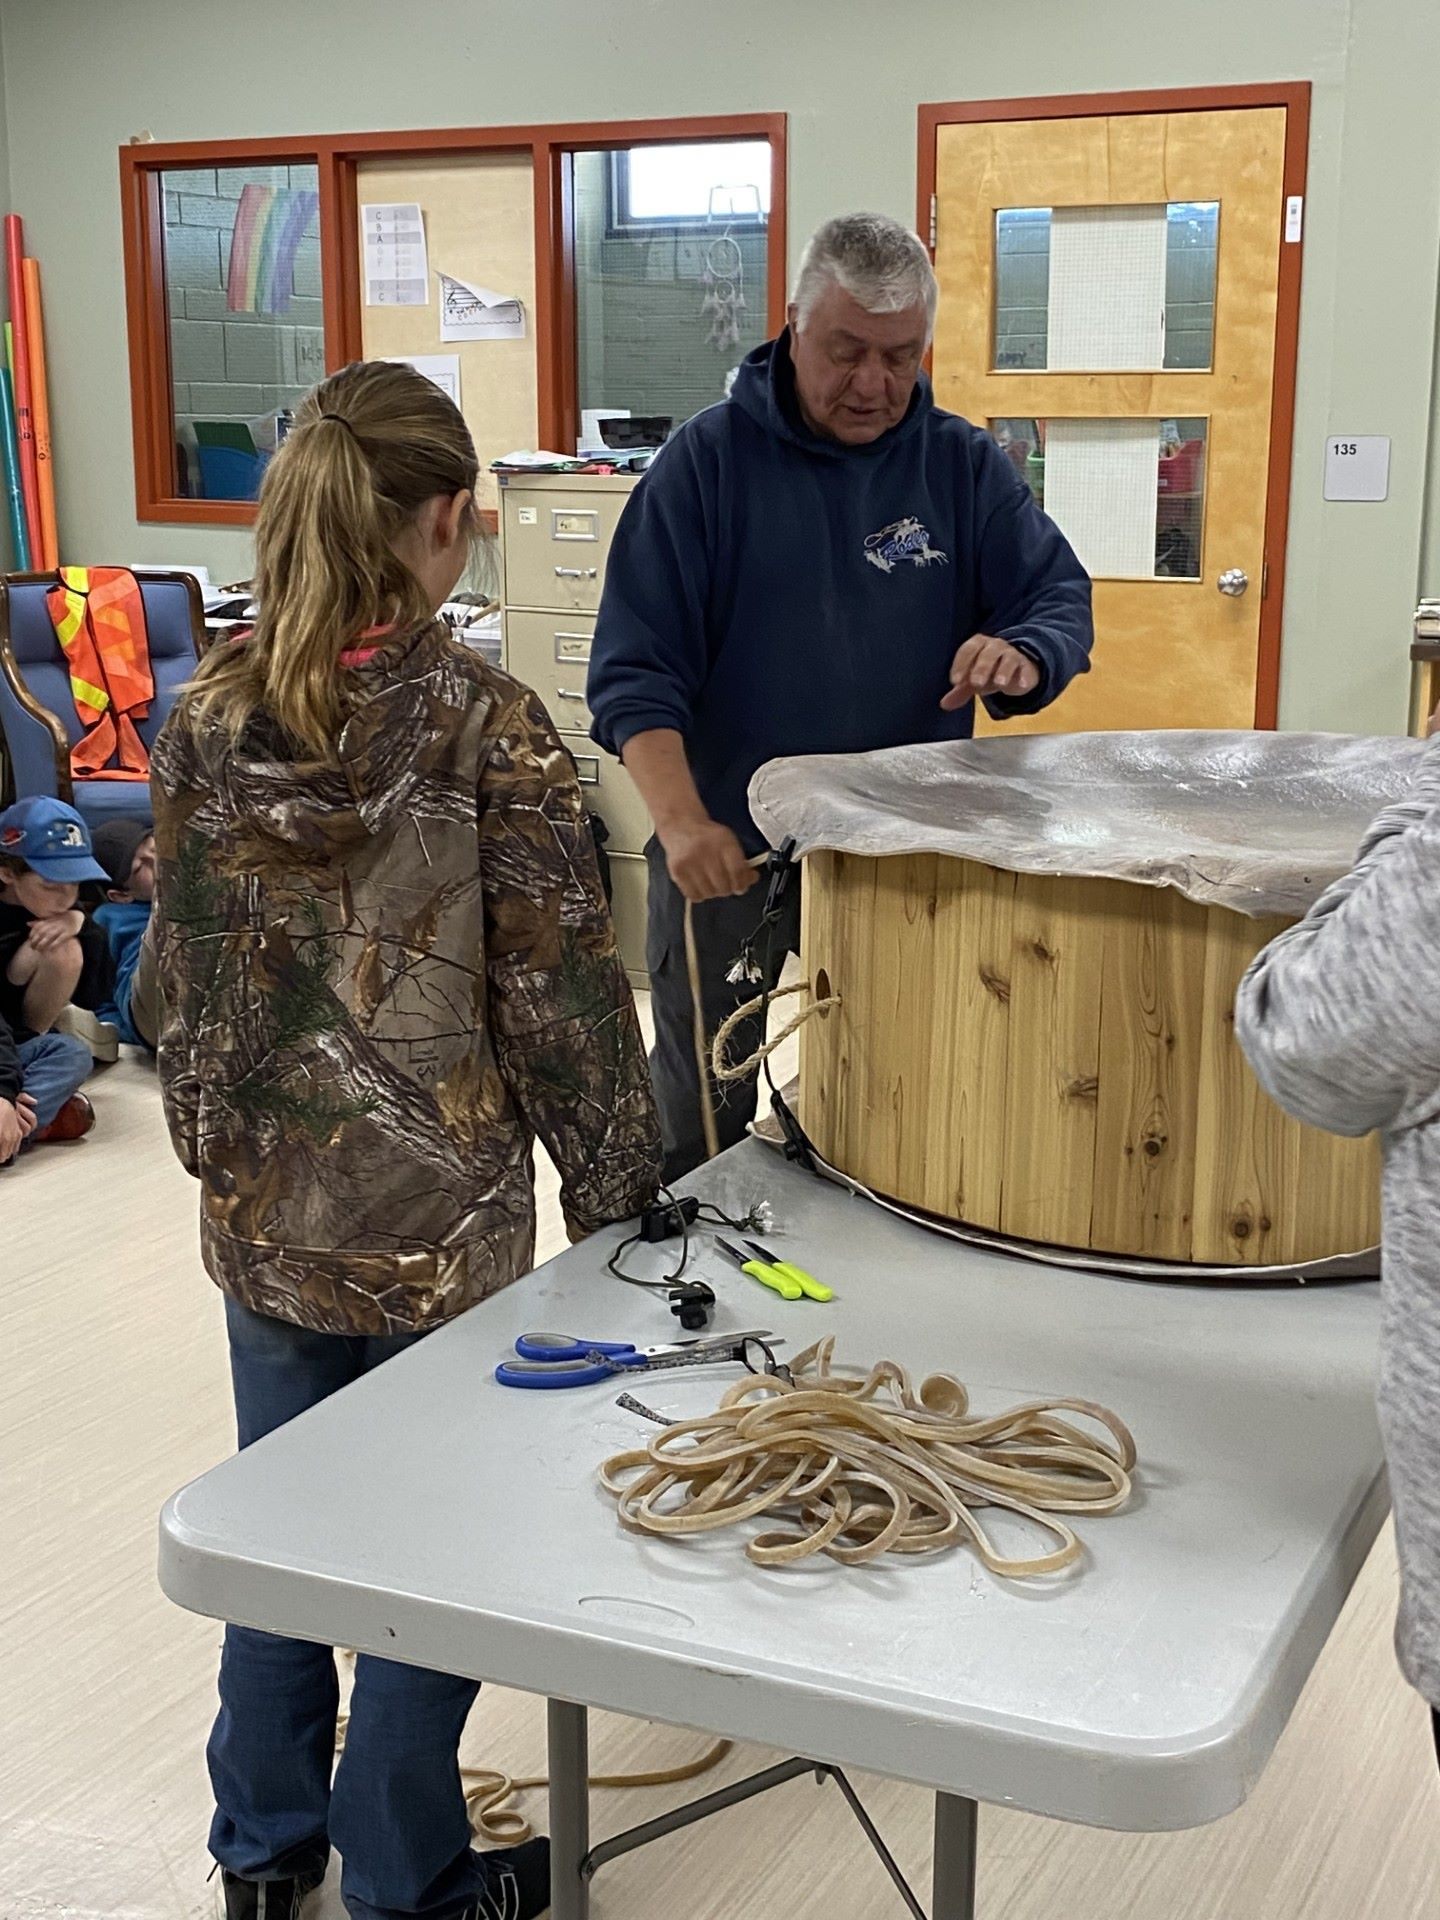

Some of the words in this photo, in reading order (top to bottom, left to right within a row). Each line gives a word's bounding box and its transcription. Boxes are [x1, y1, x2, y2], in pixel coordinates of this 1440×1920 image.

[375, 211, 382, 220] C
[376, 235, 384, 244] A
[378, 292, 385, 302] C
[1333, 443, 1357, 456] 135
[879, 529, 930, 562] Rodeo
